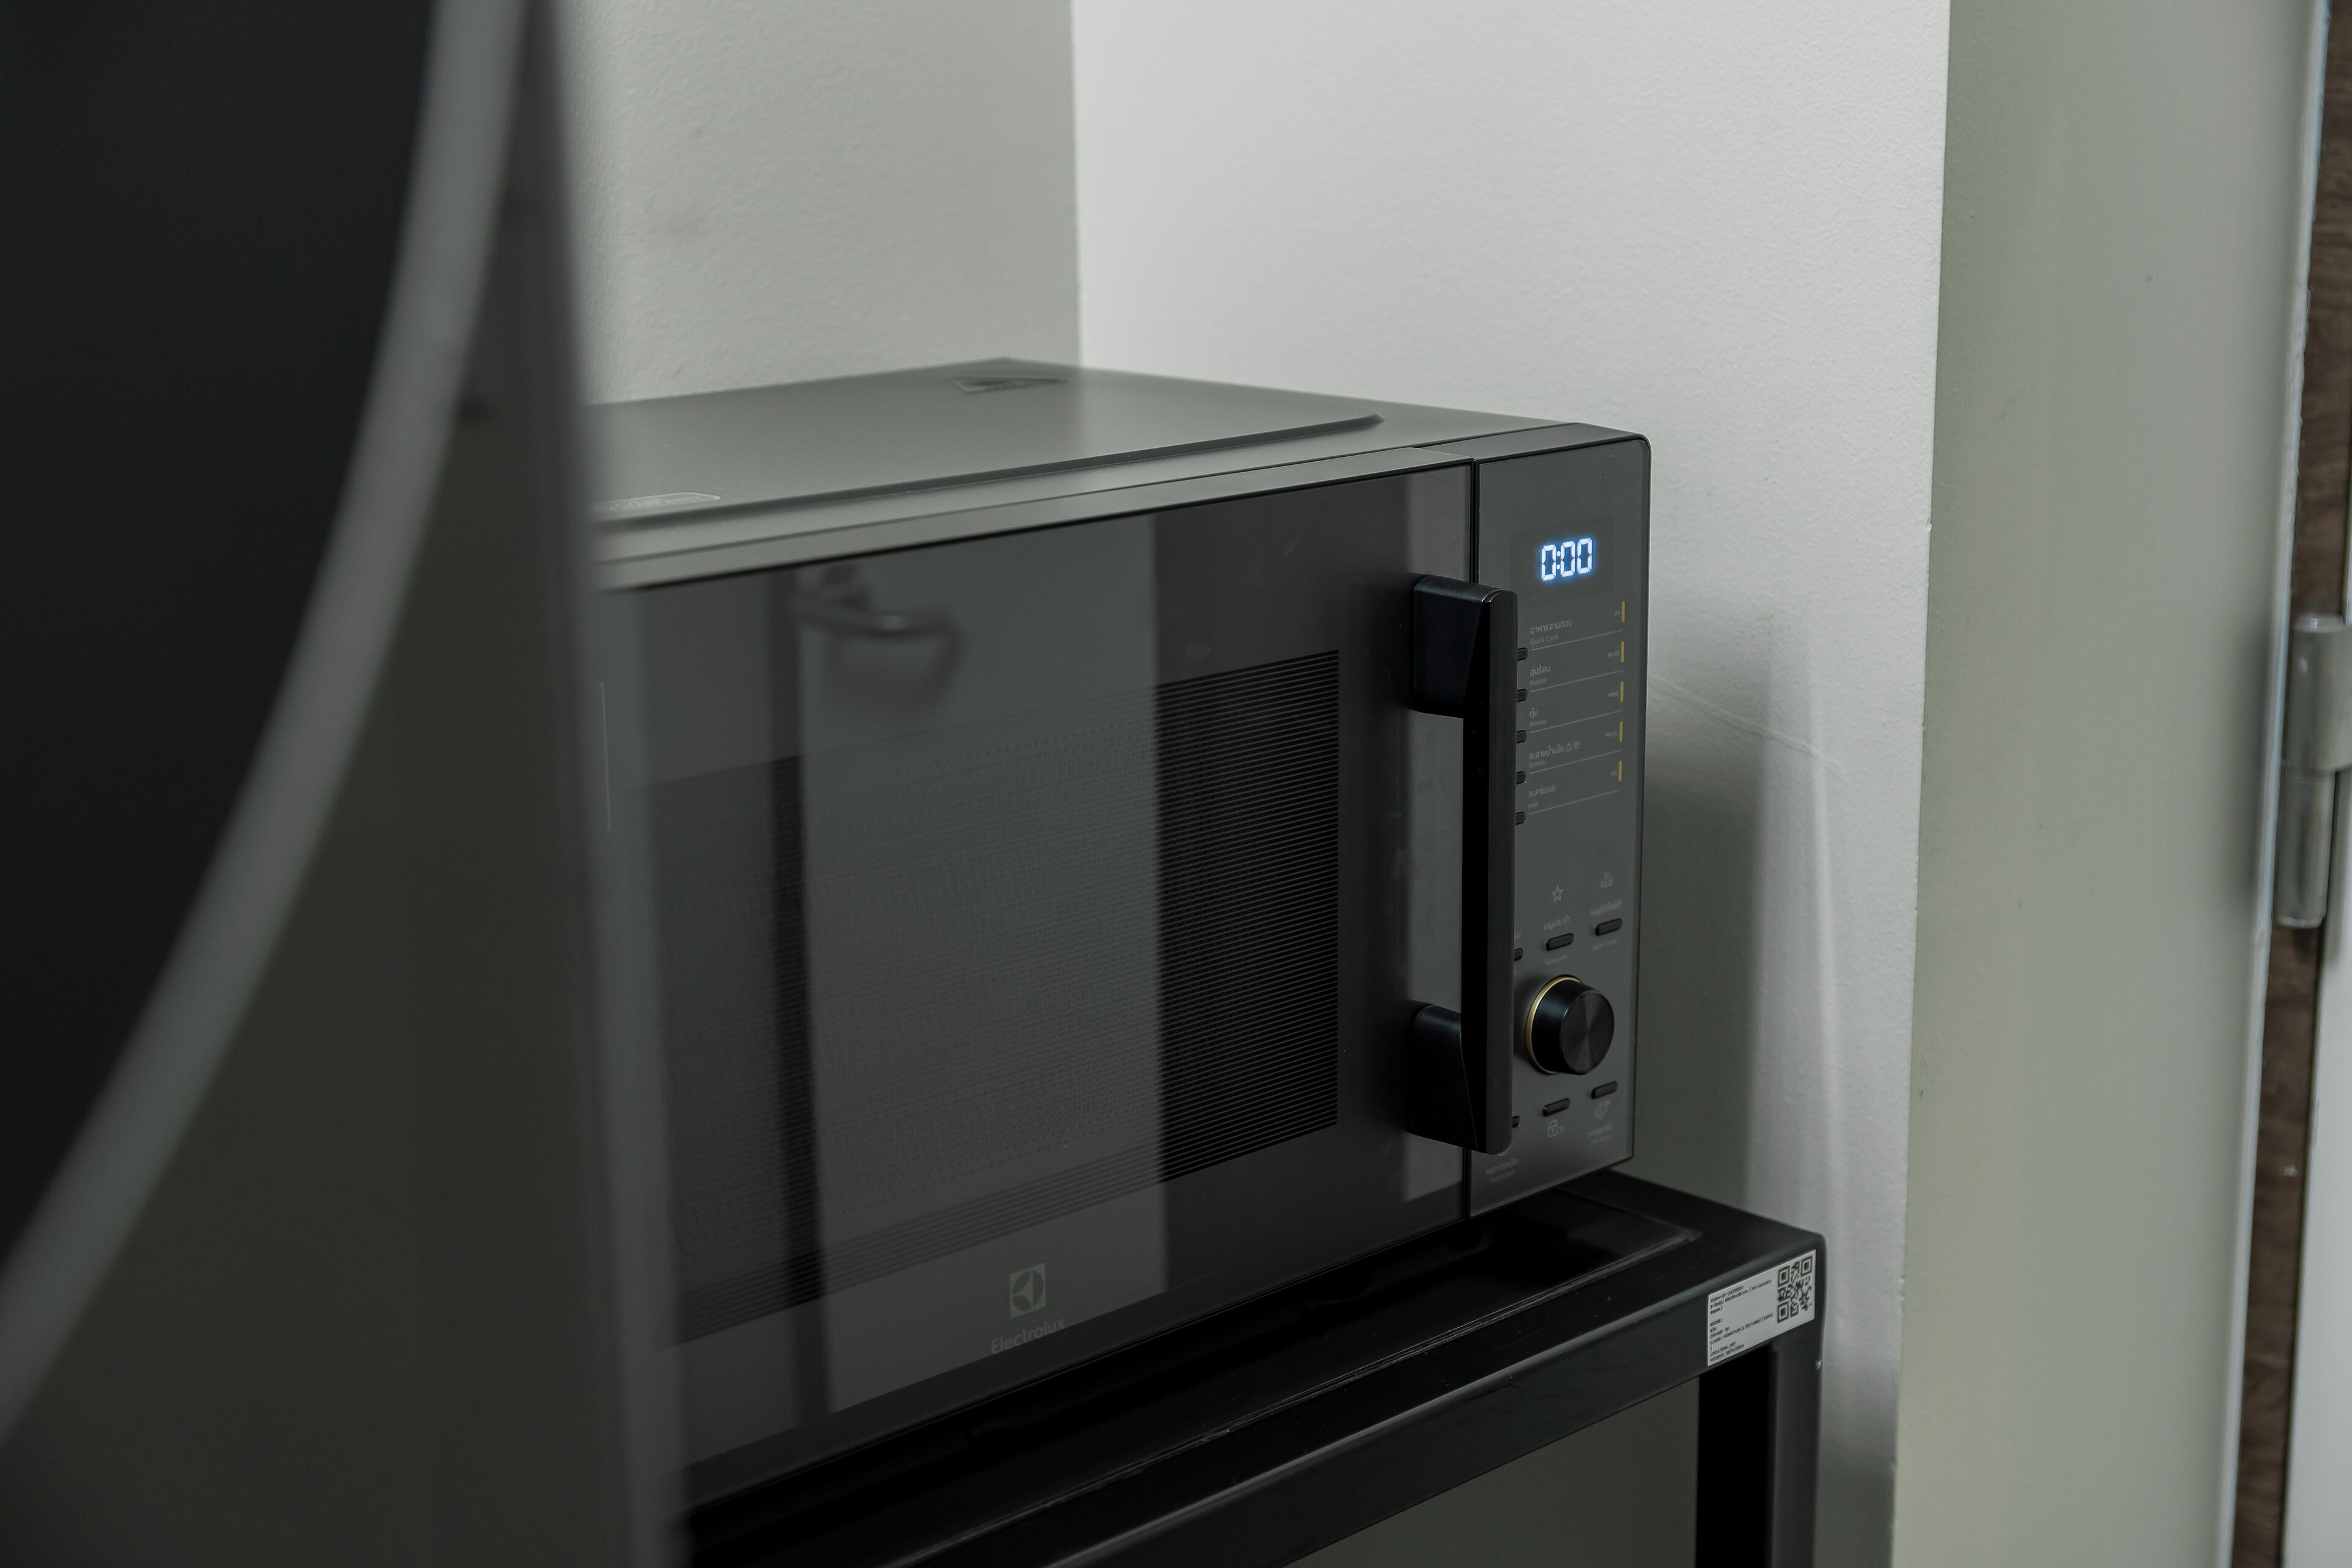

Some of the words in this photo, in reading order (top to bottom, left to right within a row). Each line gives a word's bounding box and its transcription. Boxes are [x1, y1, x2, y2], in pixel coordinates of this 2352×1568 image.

[1542, 537, 1593, 581] 0:00
[1529, 617, 1573, 635] อาหารจานด่วน
[1530, 636, 1545, 646] Quick
[1529, 665, 1551, 677] อุ่นร้อน
[991, 1319, 1065, 1355] Electrolux
